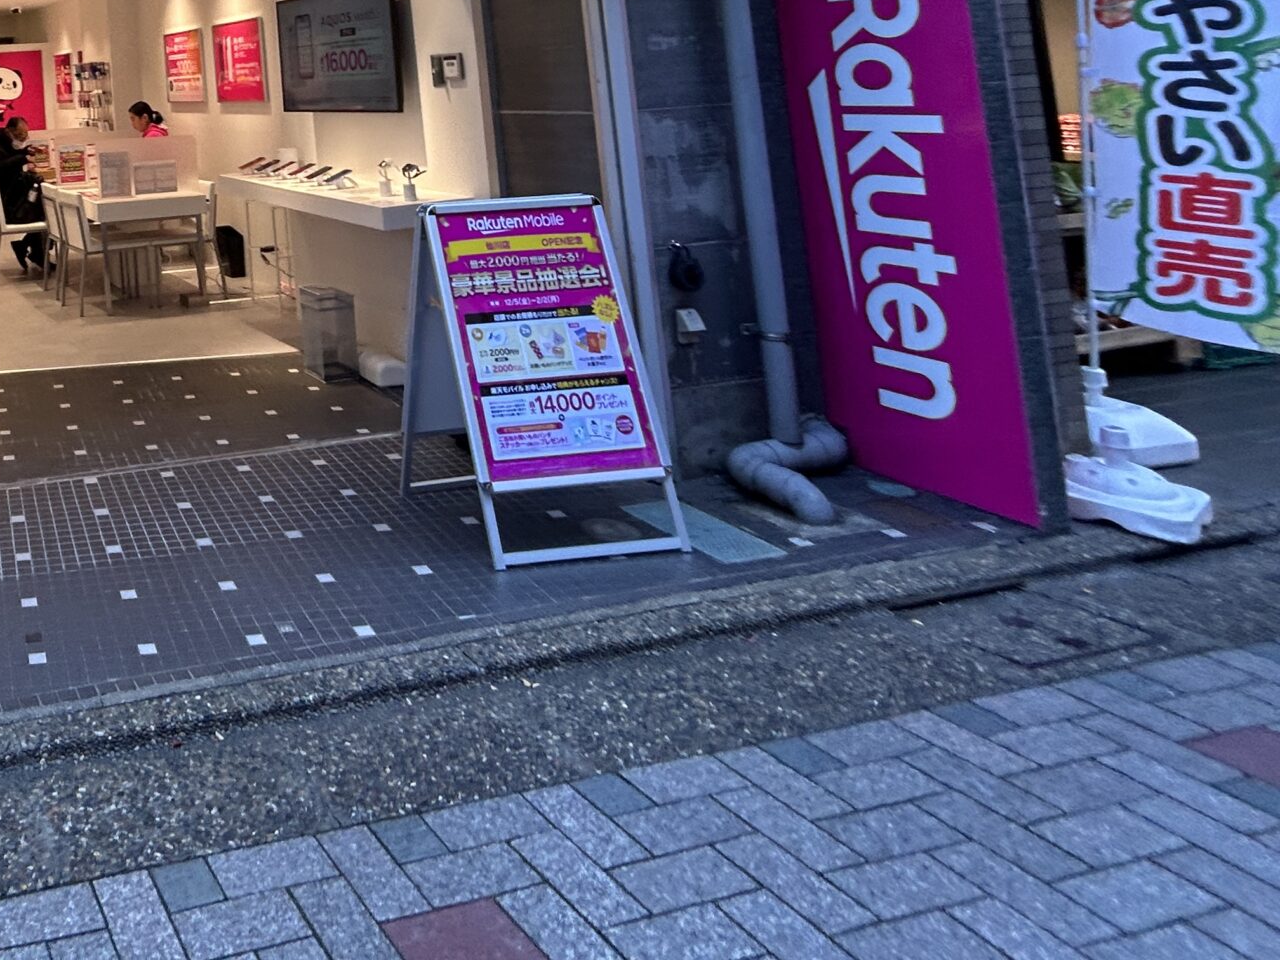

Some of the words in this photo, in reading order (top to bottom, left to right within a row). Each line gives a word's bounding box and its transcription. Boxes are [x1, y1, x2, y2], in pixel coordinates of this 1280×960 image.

[466, 214, 524, 234] Rakuten
[523, 212, 565, 228] Mobile
[451, 263, 610, 297] 豪華景品抽選会!
[535, 391, 596, 415] 14,000
